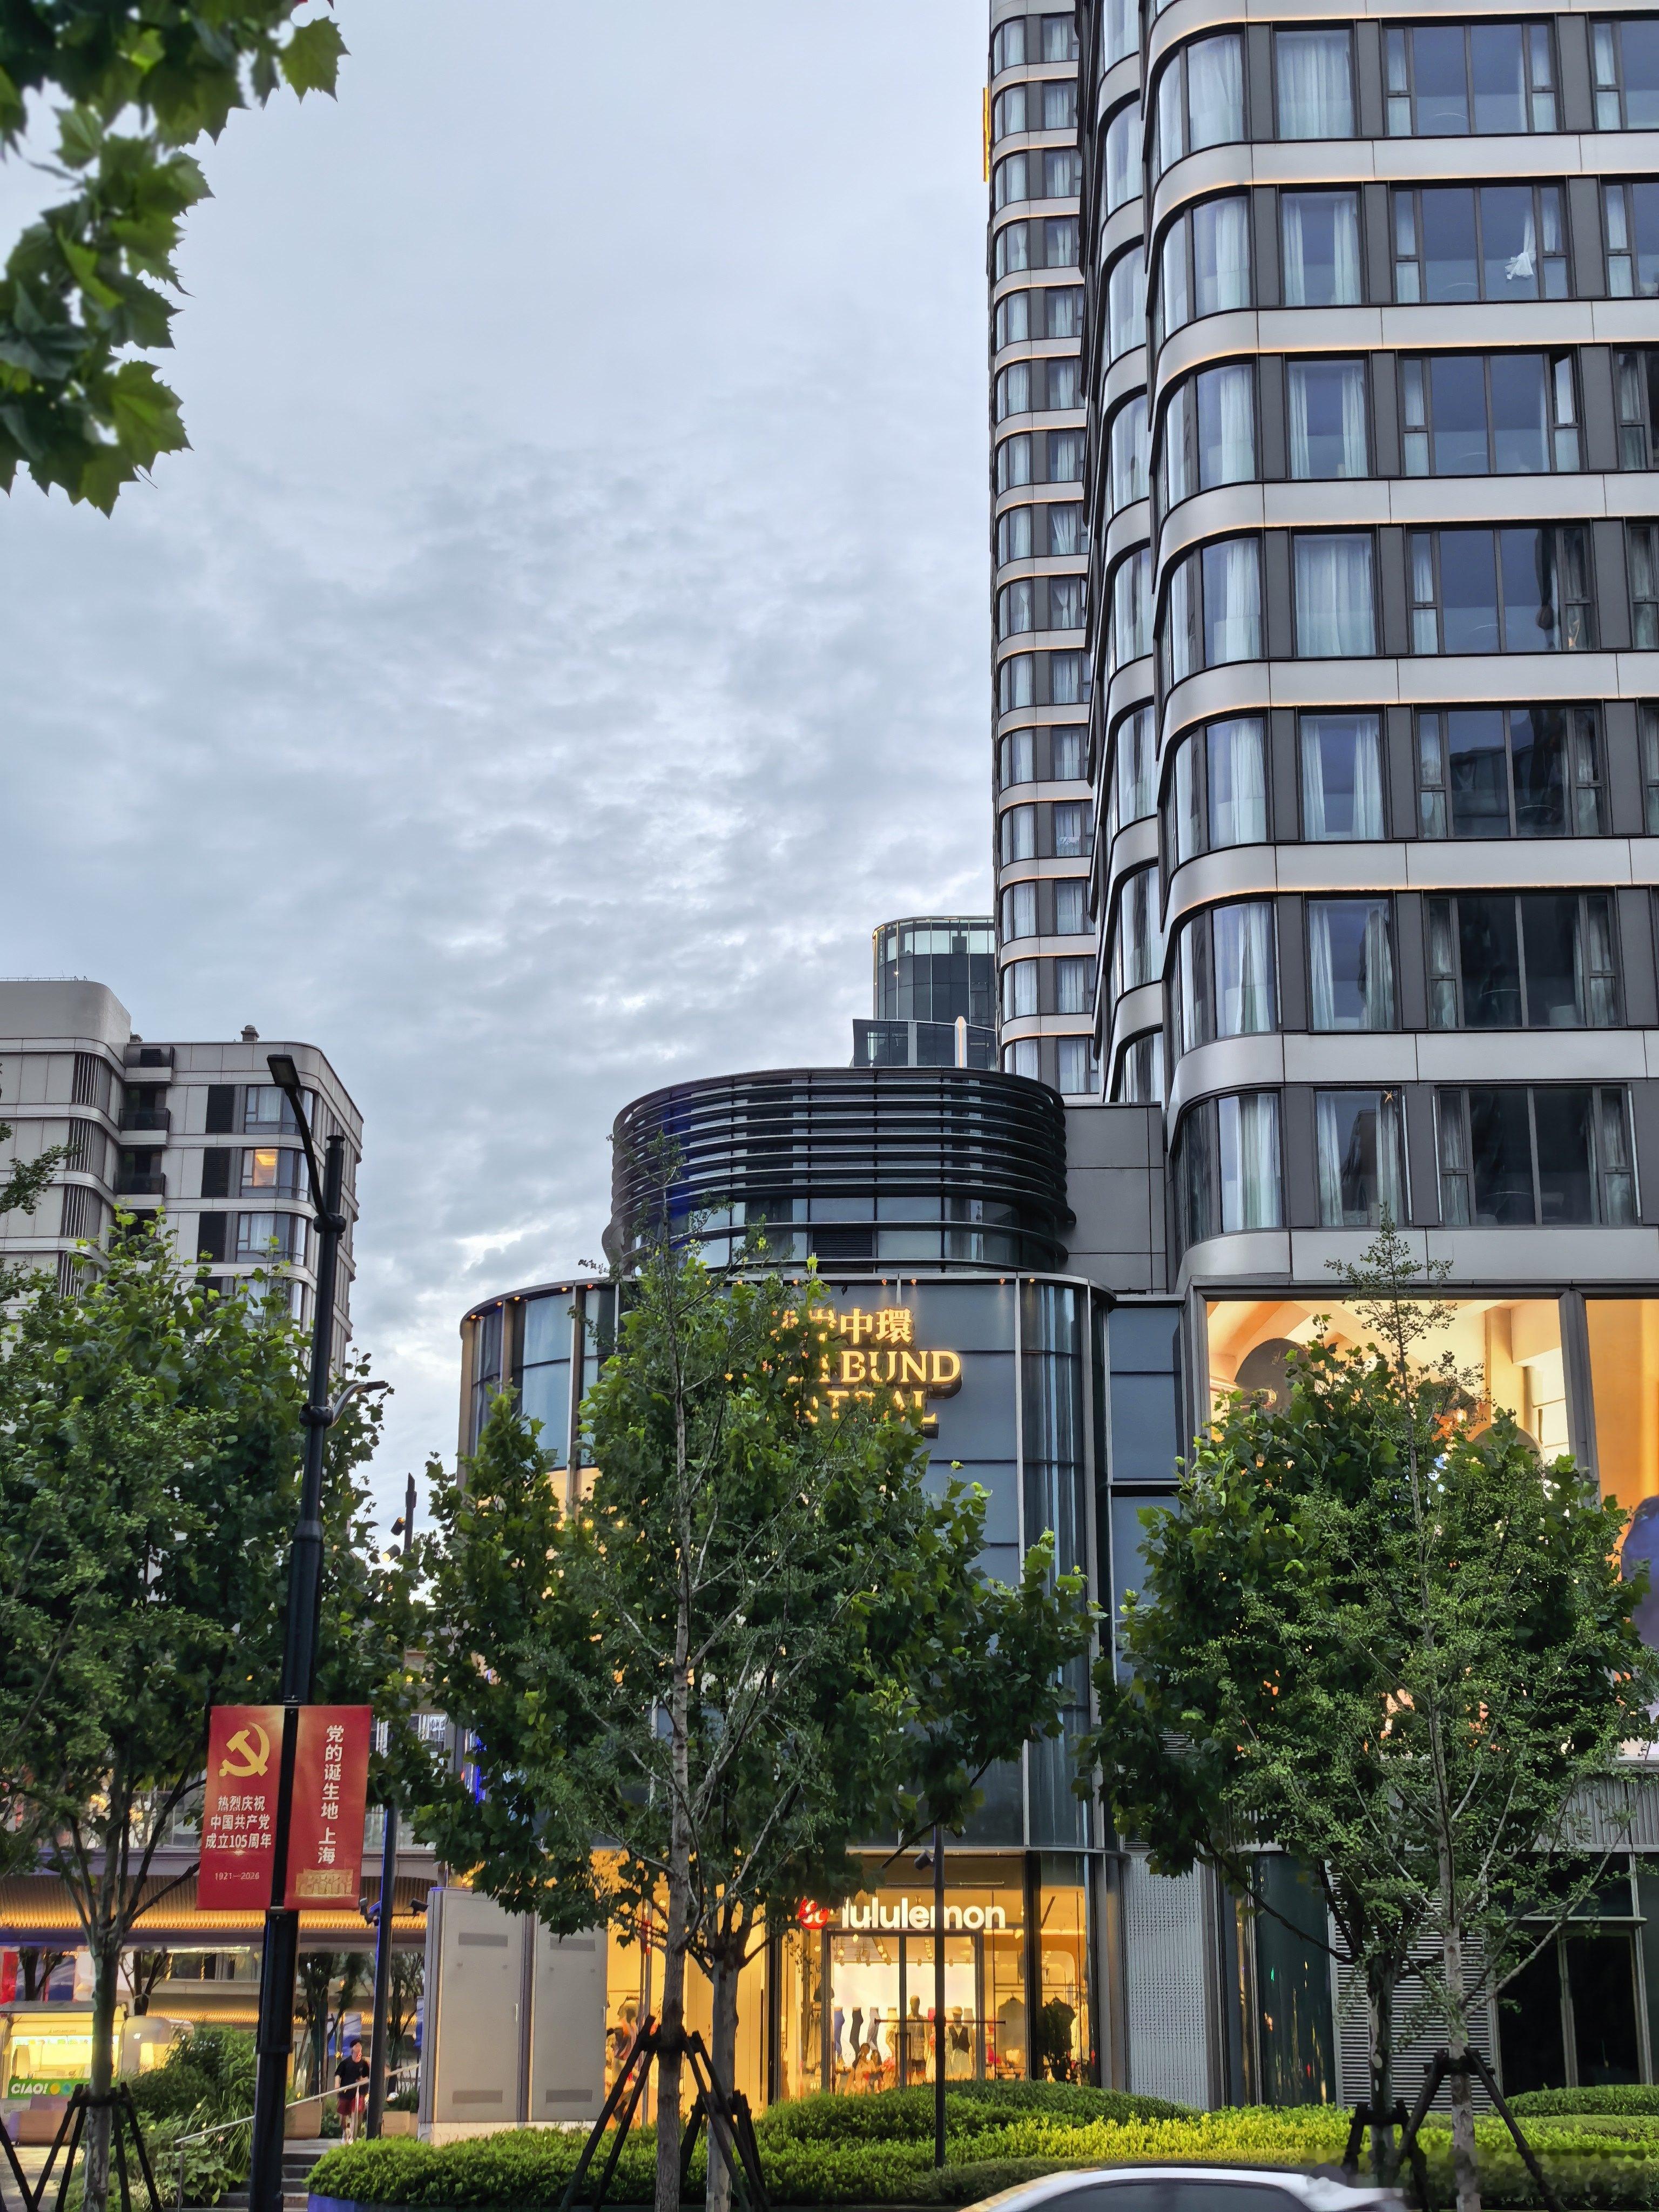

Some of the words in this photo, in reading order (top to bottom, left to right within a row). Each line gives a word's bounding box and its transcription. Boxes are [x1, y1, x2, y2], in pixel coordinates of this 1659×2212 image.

[781, 1308, 913, 1344] 中環
[840, 1350, 961, 1383] BUND
[320, 1725, 345, 1820] 党的诞生地
[217, 1795, 266, 1812] 热烈庆祝
[210, 1813, 270, 1831] 中国共产党
[205, 1832, 272, 1849] 成立105周年
[317, 1826, 336, 1864] 上海
[841, 1897, 1006, 1929] lululemon
[11, 2082, 49, 2095] CIAO!
